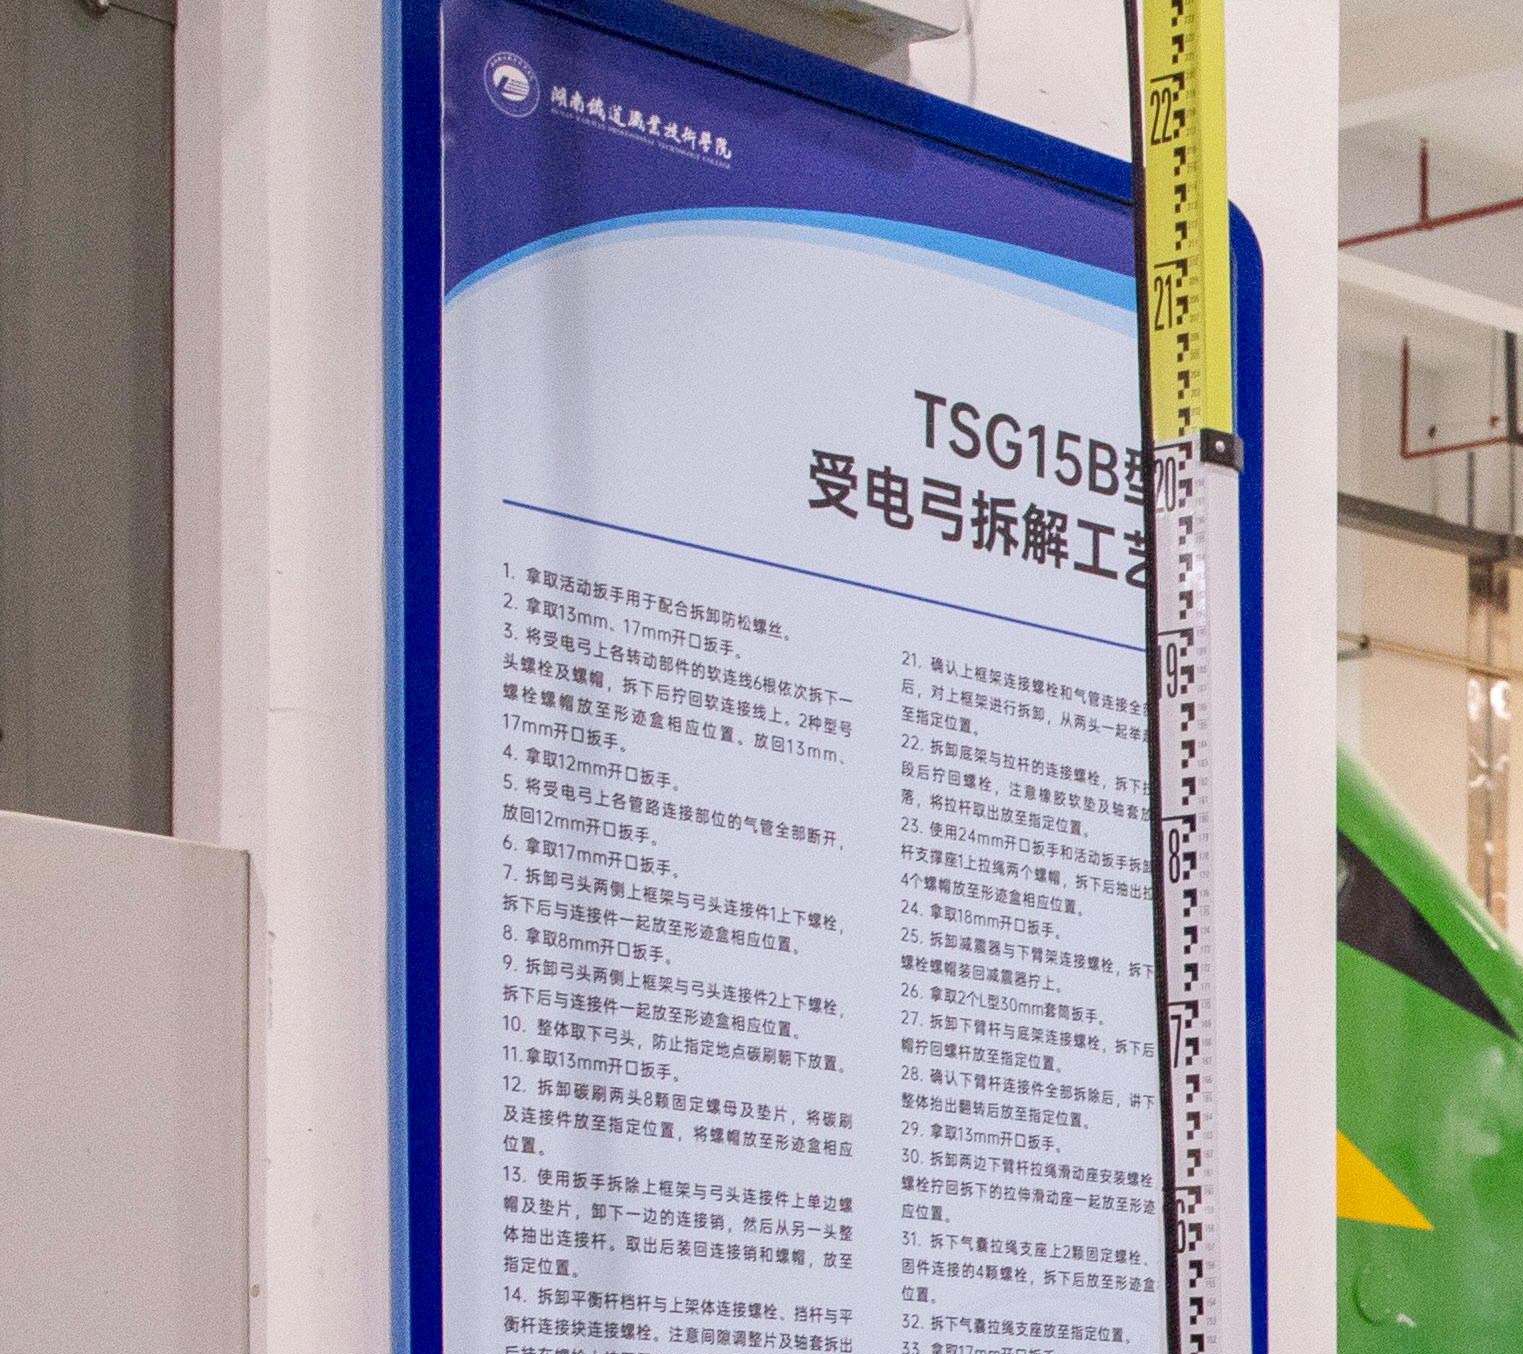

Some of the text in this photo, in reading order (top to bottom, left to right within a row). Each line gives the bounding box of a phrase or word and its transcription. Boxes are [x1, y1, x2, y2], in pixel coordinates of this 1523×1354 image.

[1150, 86, 1172, 146] 22
[1154, 273, 1173, 331] 21
[503, 562, 515, 579] 1.
[503, 593, 518, 609] 2.
[503, 623, 518, 639] 3.
[902, 651, 922, 668] 21.
[902, 706, 978, 736] 至指定位置。
[503, 714, 626, 752] 17mm开口扳手。
[901, 734, 923, 751] 22.
[503, 745, 678, 792] 4. 拿取12mm开口扳手。
[503, 774, 518, 790] 5.
[503, 803, 658, 846] 放回12mm开口扳手。
[901, 817, 923, 834] 23.
[503, 835, 679, 878] 6. 拿取17mm开口扳手。
[503, 865, 518, 881] 7.
[901, 900, 1060, 939] 24. 拿取18mm开口扳手。
[901, 927, 923, 944] 25.
[503, 925, 671, 965] 8. 拿取8mm开口扳手。
[503, 955, 518, 971] 9.
[901, 983, 923, 998] 26.
[503, 1016, 526, 1032] 10.
[901, 1010, 923, 1026] 27.
[901, 1066, 923, 1081] 28.
[503, 1077, 526, 1093] 12.
[901, 1121, 1061, 1152] 29. 拿取13mm开口扳手。
[504, 1135, 544, 1156] 位置。
[901, 1149, 923, 1164] 30.
[503, 1167, 526, 1183] 13.
[901, 1204, 950, 1223] 应位置。
[902, 1232, 921, 1247] 31.
[504, 1256, 578, 1278] 指定位置。
[504, 1287, 526, 1302] 14.
[902, 1286, 936, 1304] 位置。
[902, 1314, 923, 1329] 32.
